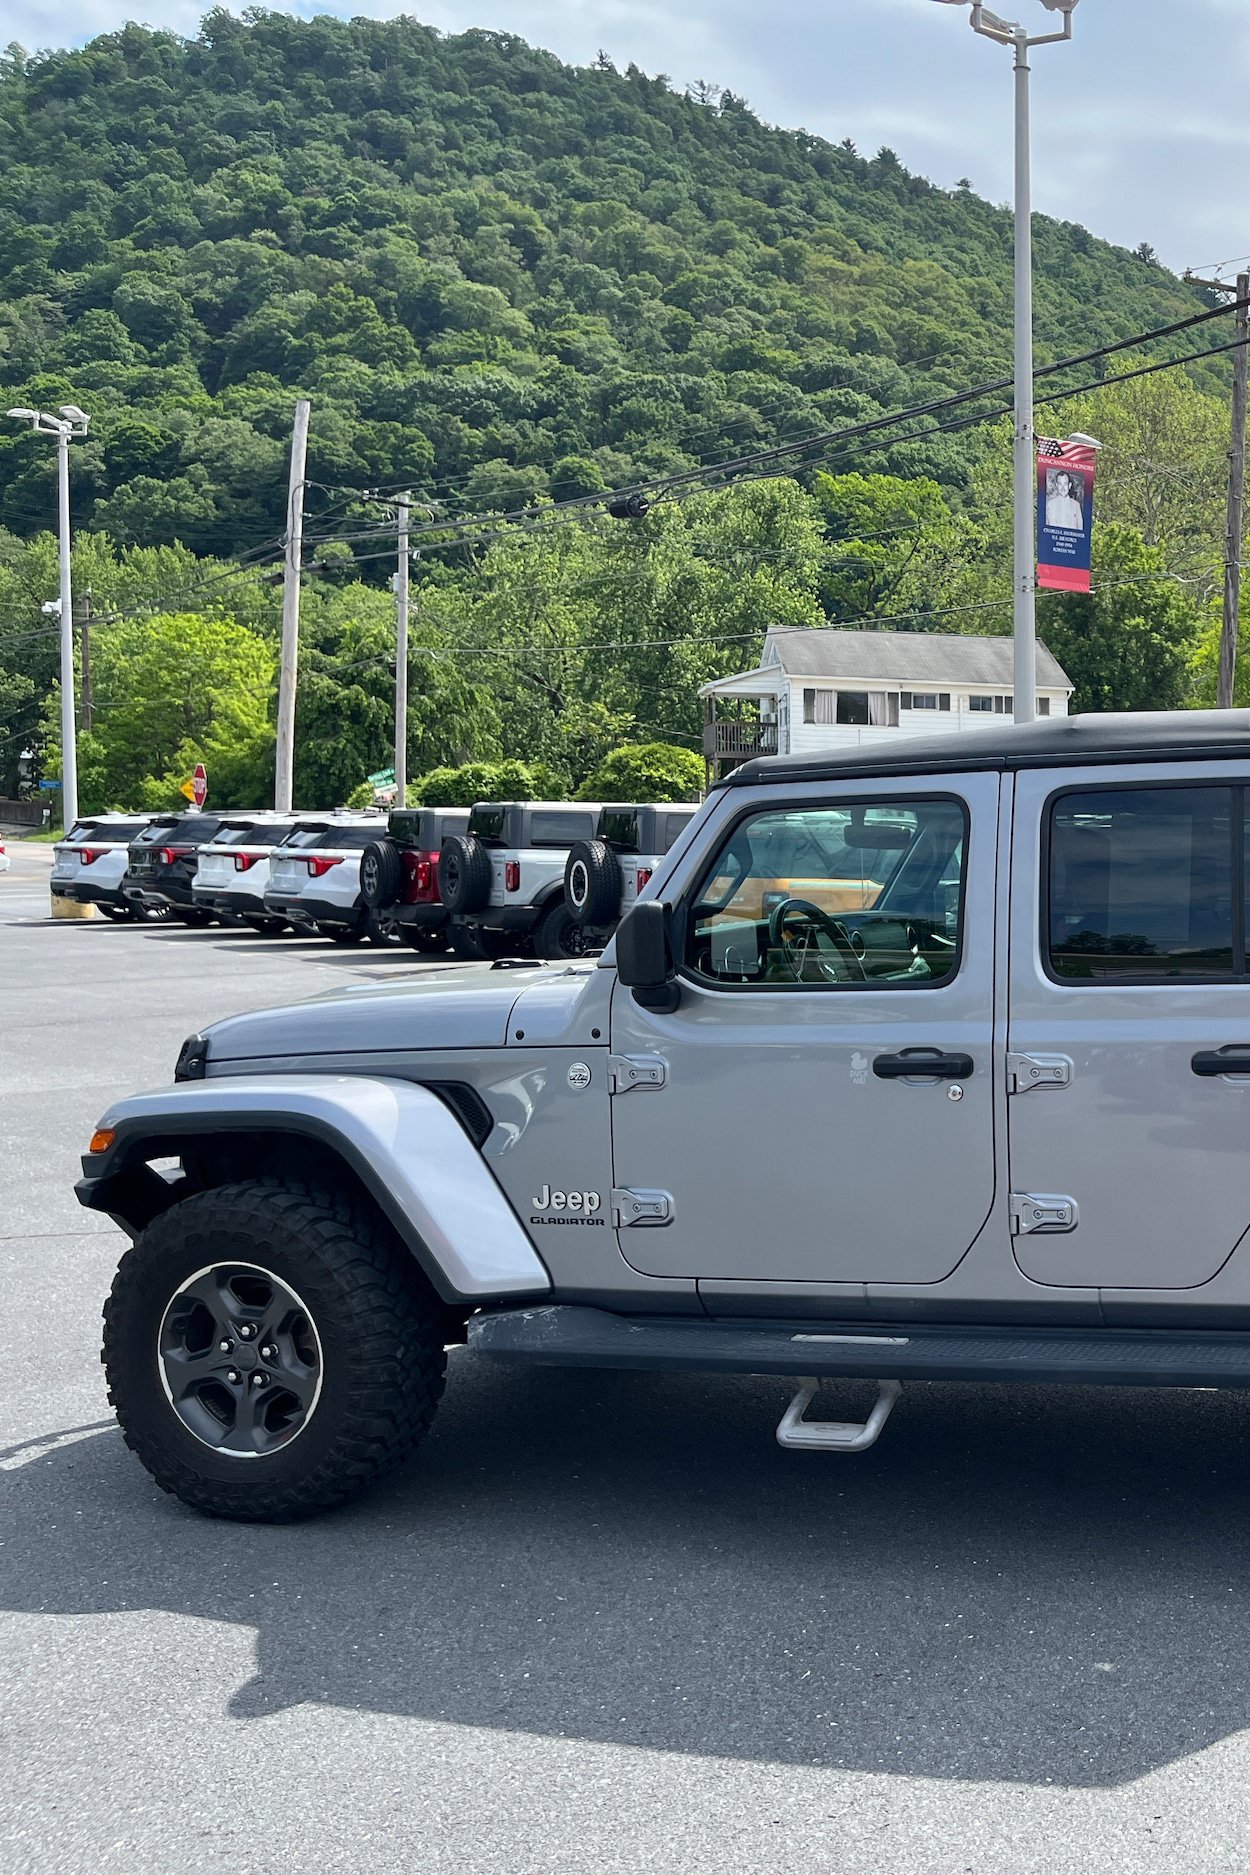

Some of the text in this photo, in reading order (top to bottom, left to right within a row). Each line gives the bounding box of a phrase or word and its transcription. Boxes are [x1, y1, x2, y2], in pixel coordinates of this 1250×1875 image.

[194, 778, 205, 794] STOP
[531, 1184, 600, 1216] Jeep
[530, 1216, 605, 1226] GLADIATOR
